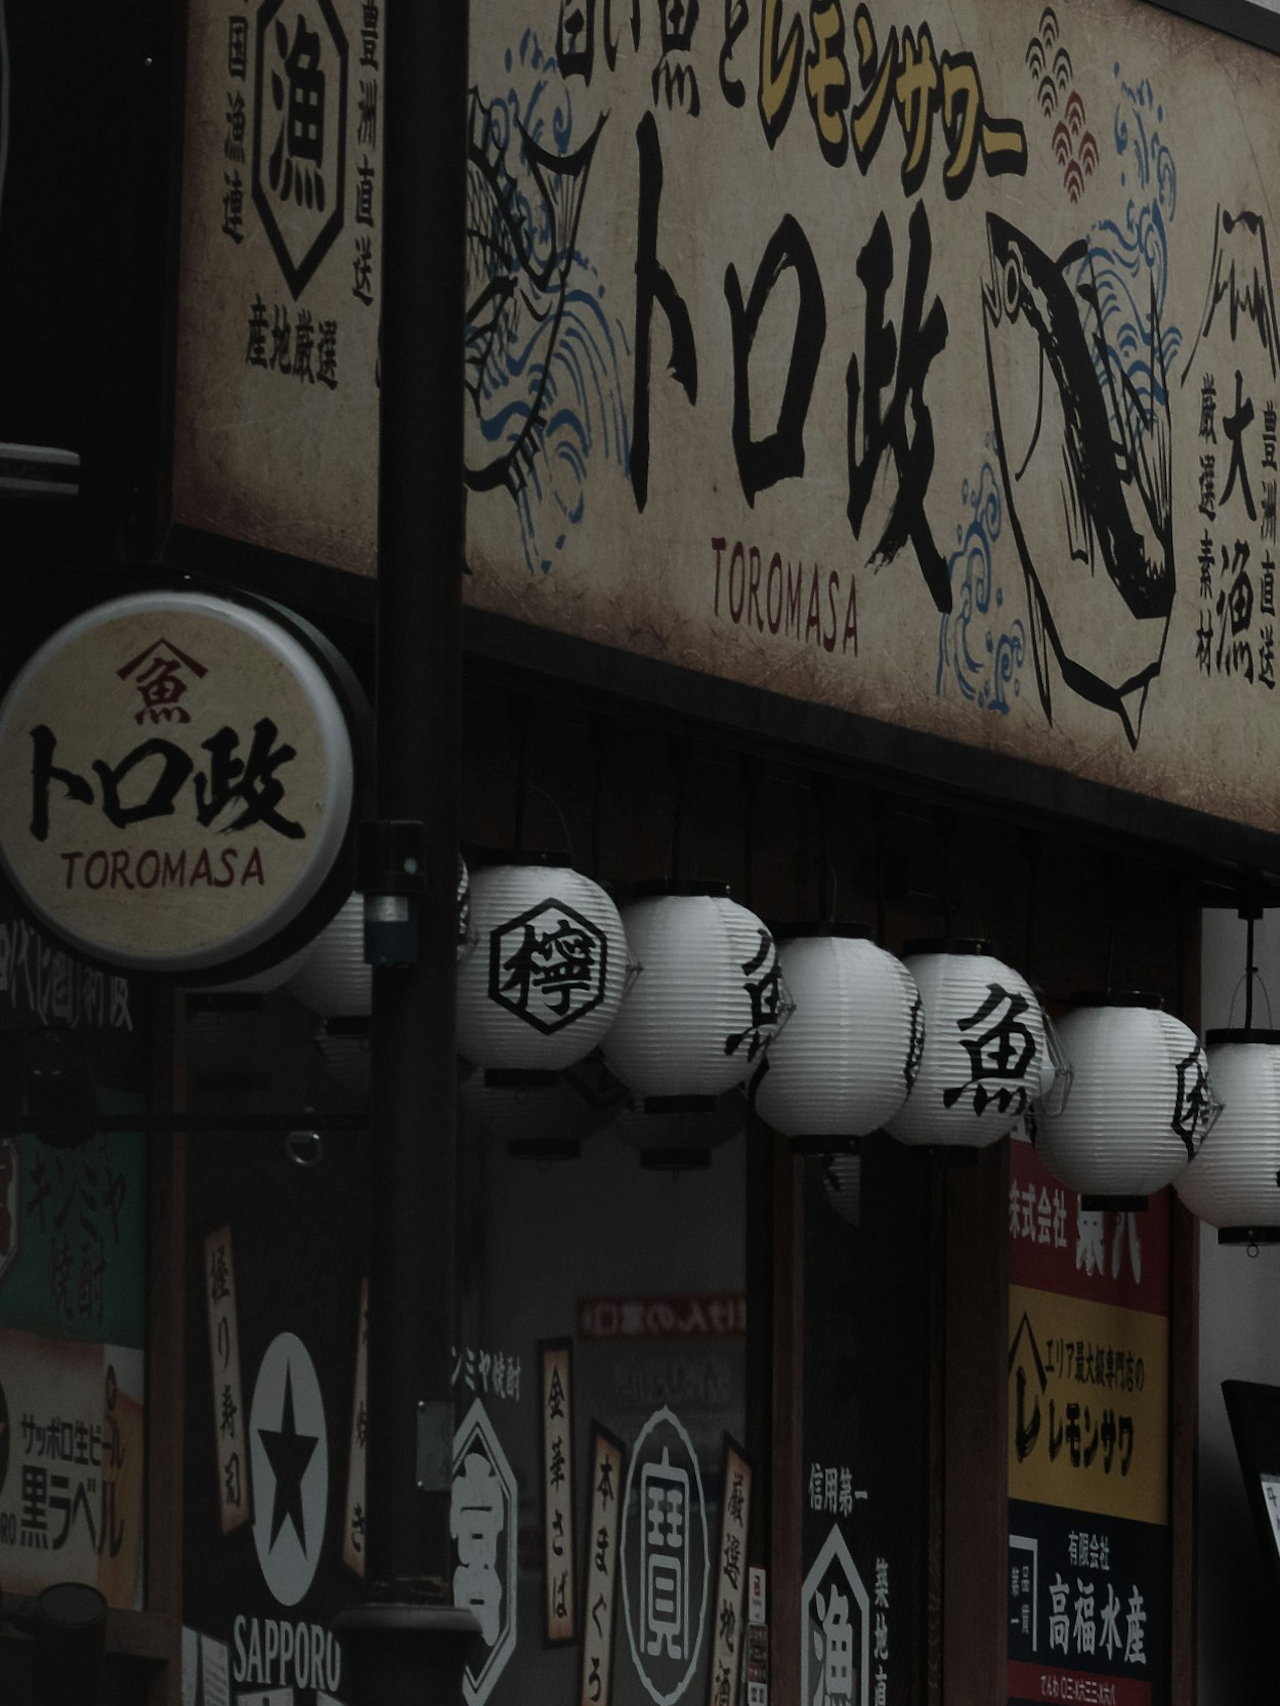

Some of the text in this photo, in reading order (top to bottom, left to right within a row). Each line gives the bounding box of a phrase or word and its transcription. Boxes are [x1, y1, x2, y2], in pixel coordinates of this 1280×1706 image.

[629, 109, 953, 614] トロ政
[1216, 370, 1257, 685] 大漁
[711, 535, 861, 658] TOROMASA
[31, 718, 305, 841] トロ政
[61, 847, 265, 890] TOROMASA
[944, 984, 1036, 1119] 魚
[450, 1345, 521, 1403] ンミヤ焼酎
[20, 1412, 125, 1468] サッポロ生ビール
[808, 1461, 869, 1521] 信用第一
[19, 1464, 125, 1559] 黒ラベル
[1068, 1530, 1110, 1572] 有限会社
[586, 1453, 616, 1704] 本まぐろ
